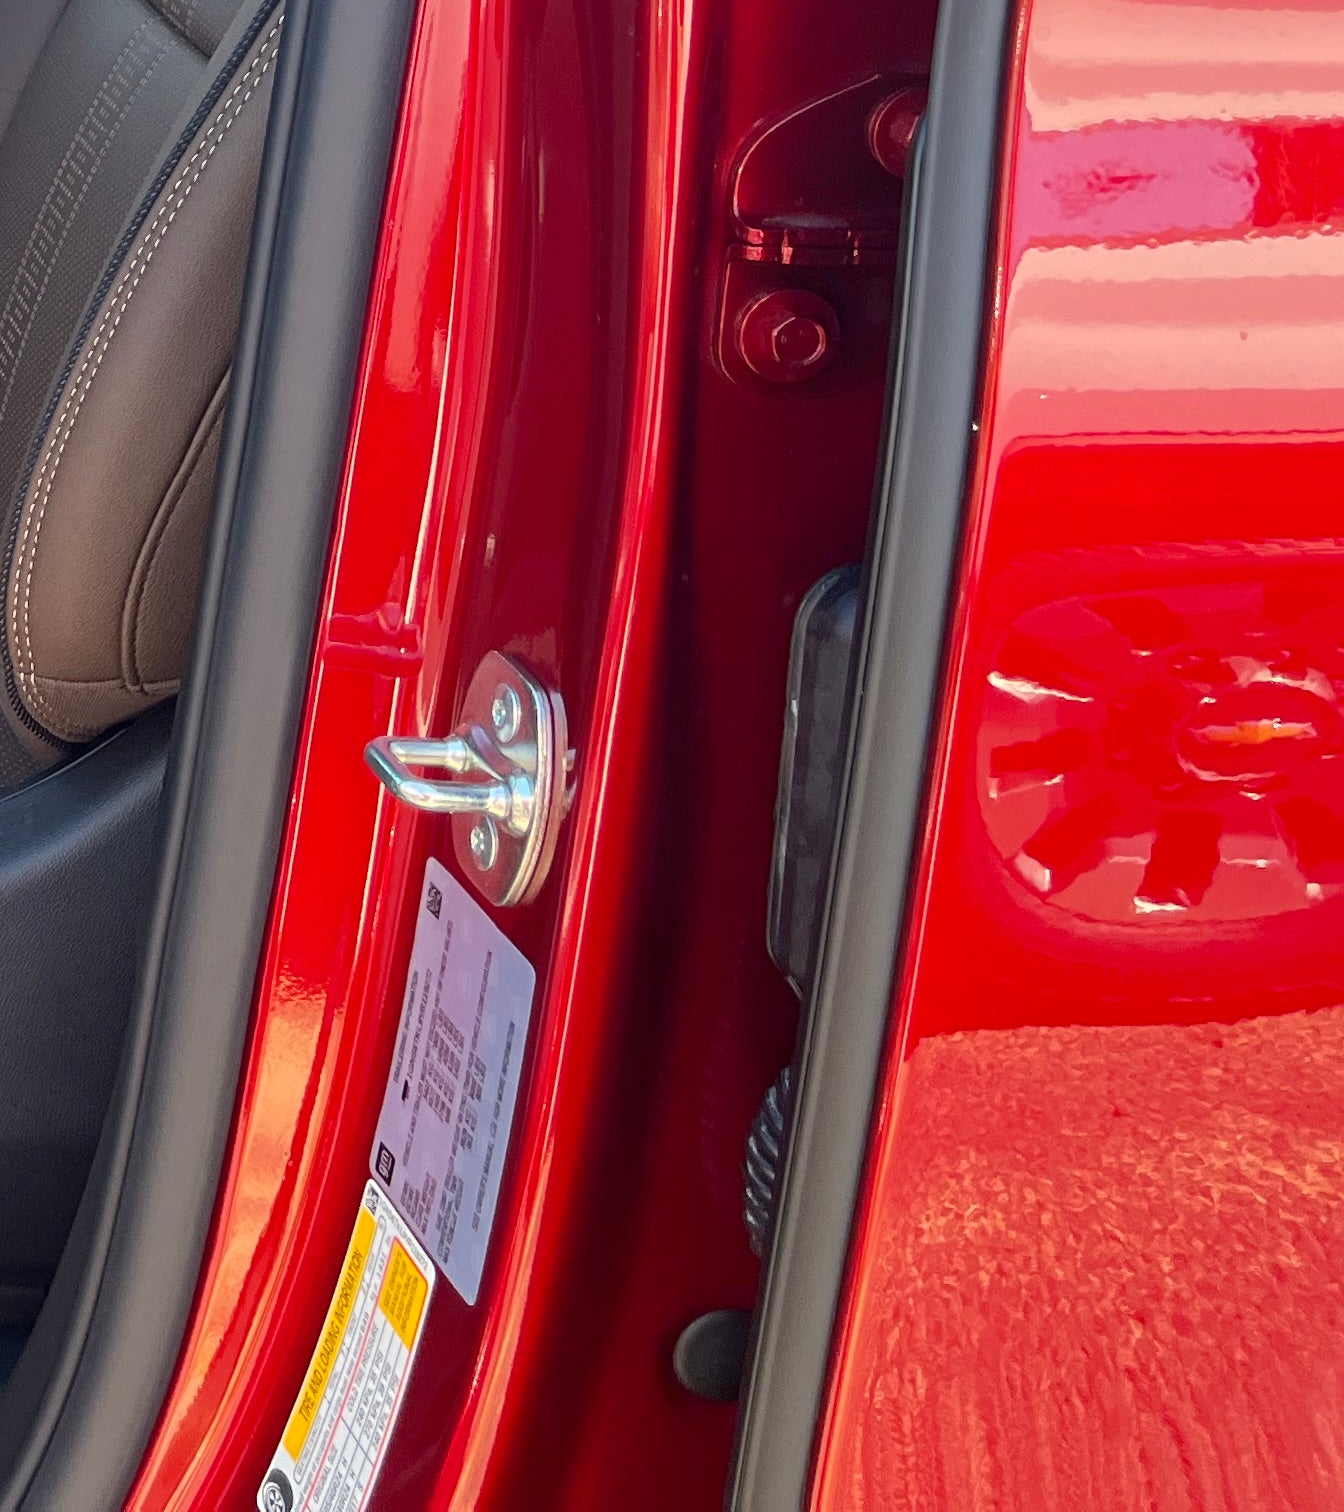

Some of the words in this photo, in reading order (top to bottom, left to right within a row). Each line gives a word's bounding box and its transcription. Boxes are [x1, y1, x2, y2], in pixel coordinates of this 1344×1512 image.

[378, 1145, 392, 1181] gm
[299, 1389, 315, 1424] TIRE
[309, 1366, 323, 1398] AND
[317, 1316, 340, 1376] LOADING
[334, 1244, 363, 1326] INFORMATION
